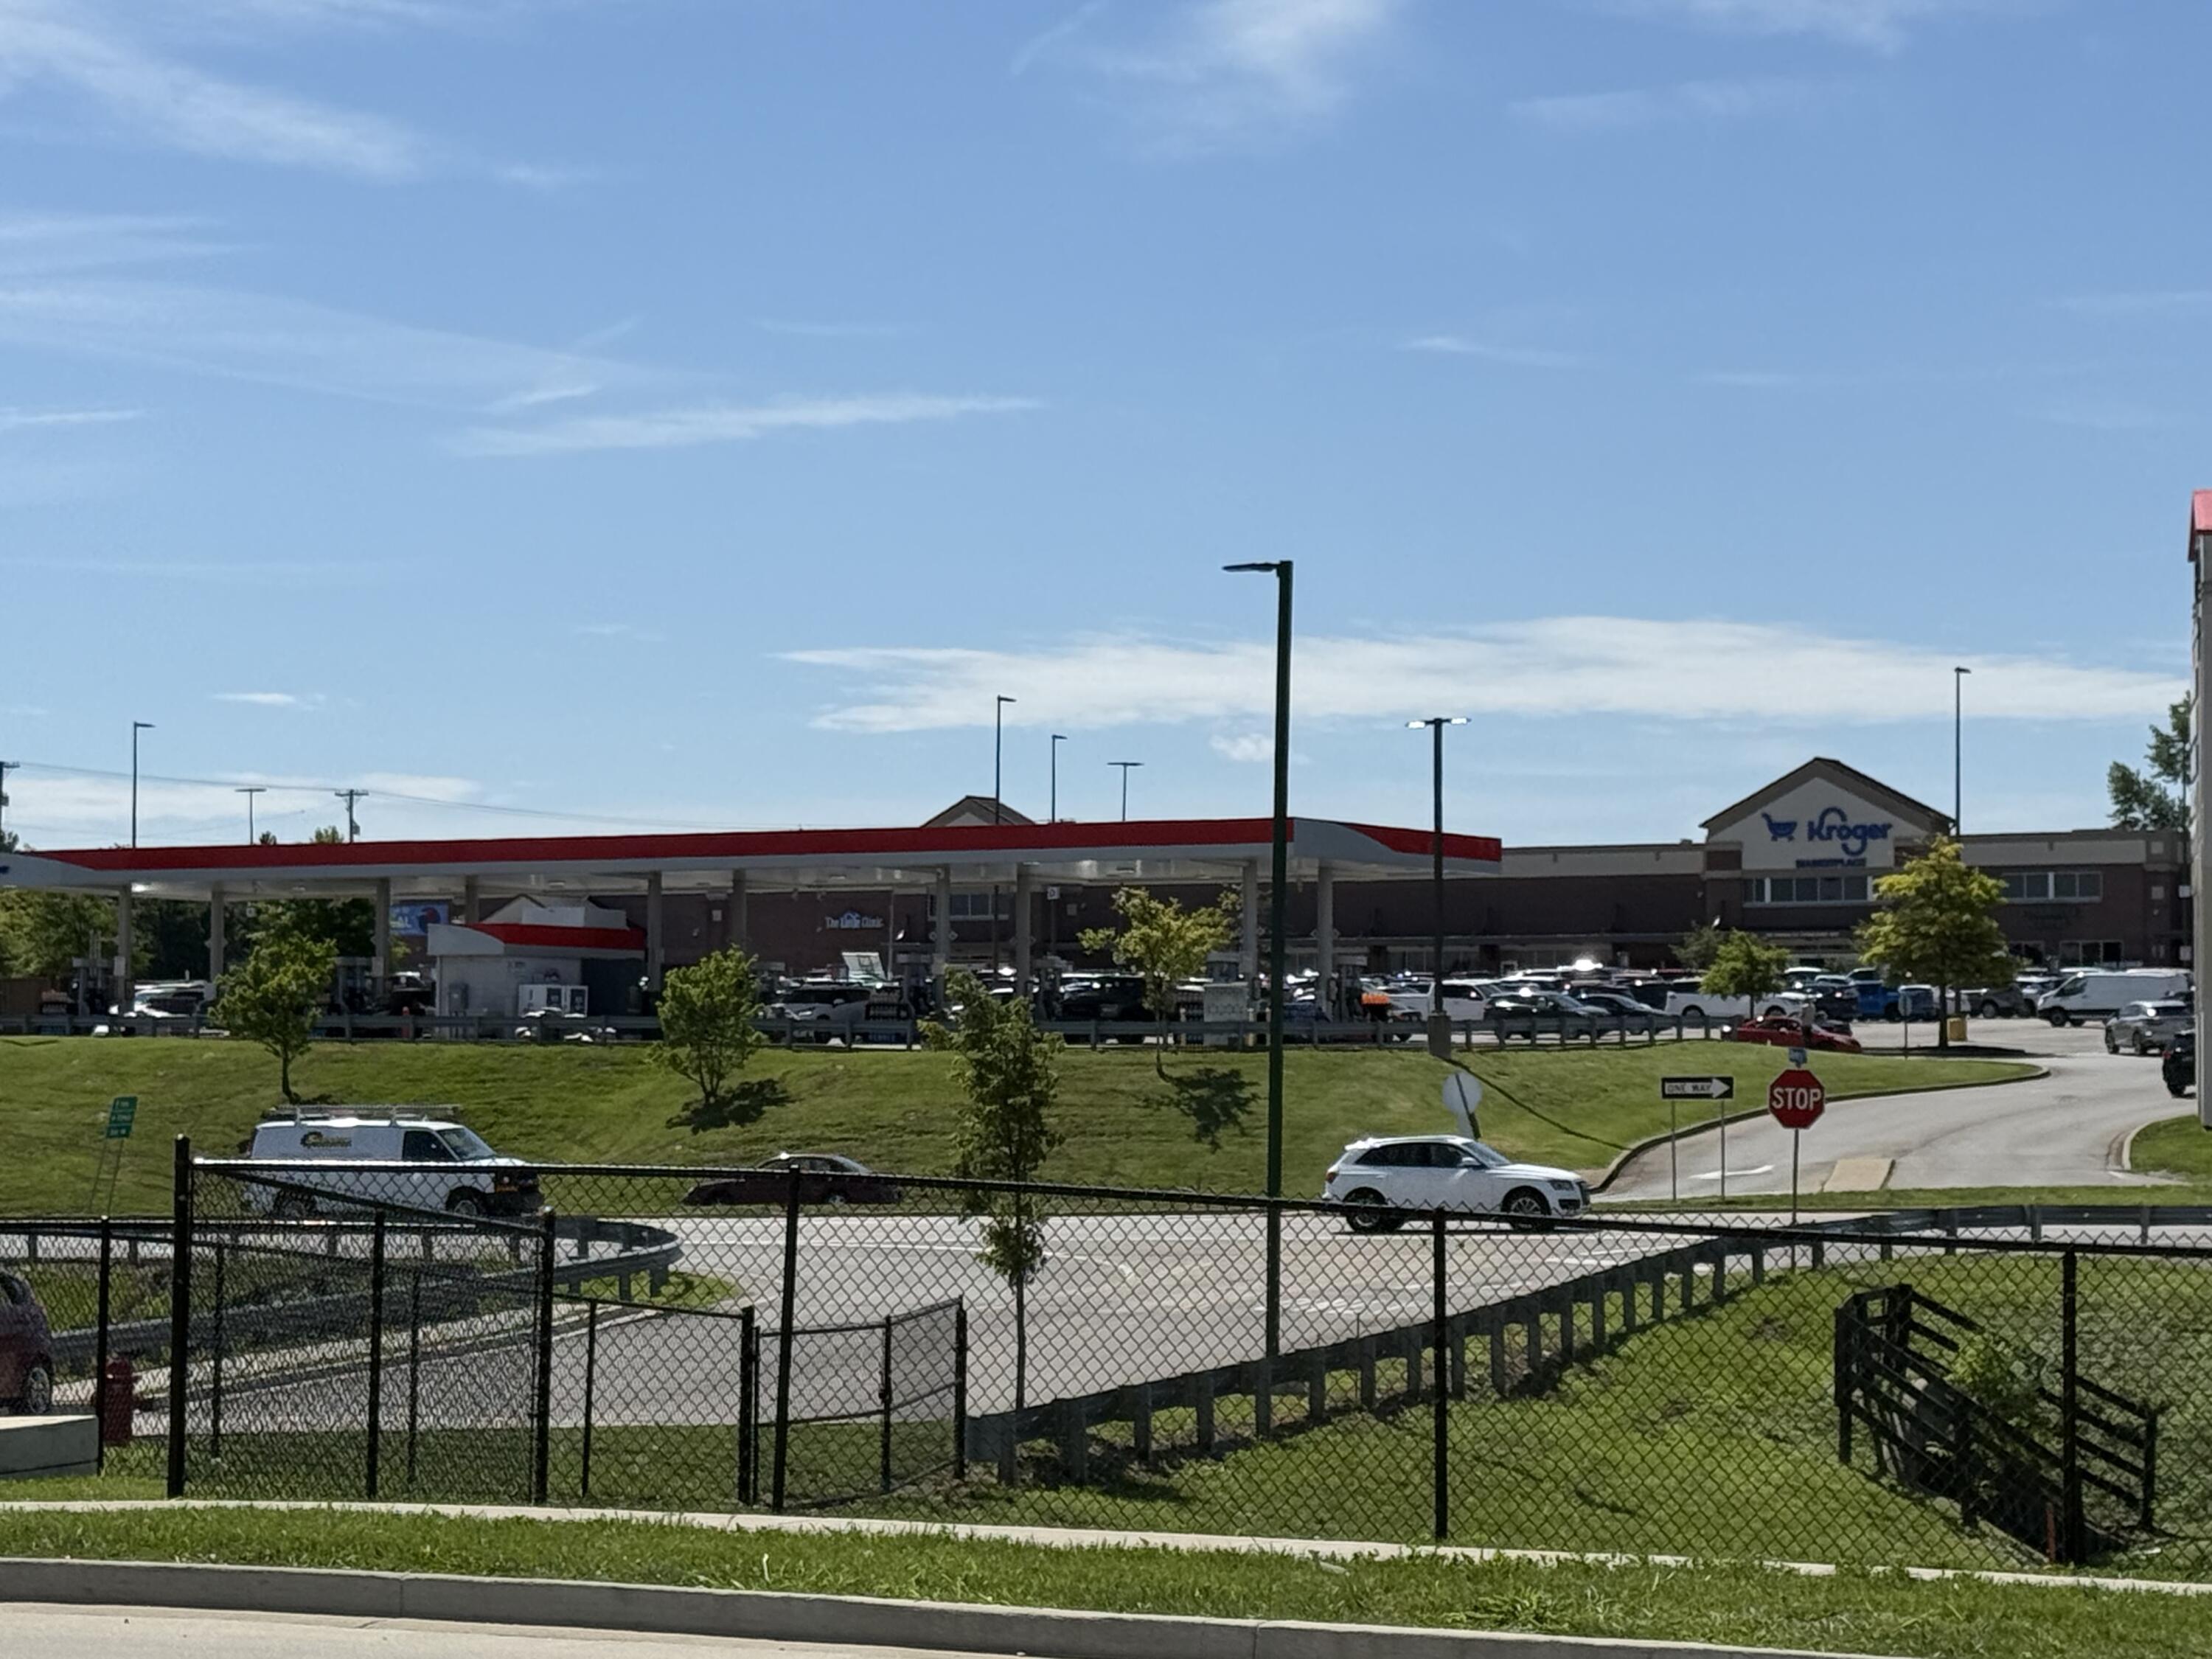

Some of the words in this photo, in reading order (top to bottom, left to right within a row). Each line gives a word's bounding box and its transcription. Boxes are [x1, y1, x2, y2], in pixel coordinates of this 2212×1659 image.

[1807, 807, 1893, 856] Kroger
[1667, 1082, 1686, 1091] ONE
[1692, 1082, 1711, 1091] WAY
[1772, 1087, 1822, 1110] STOP
